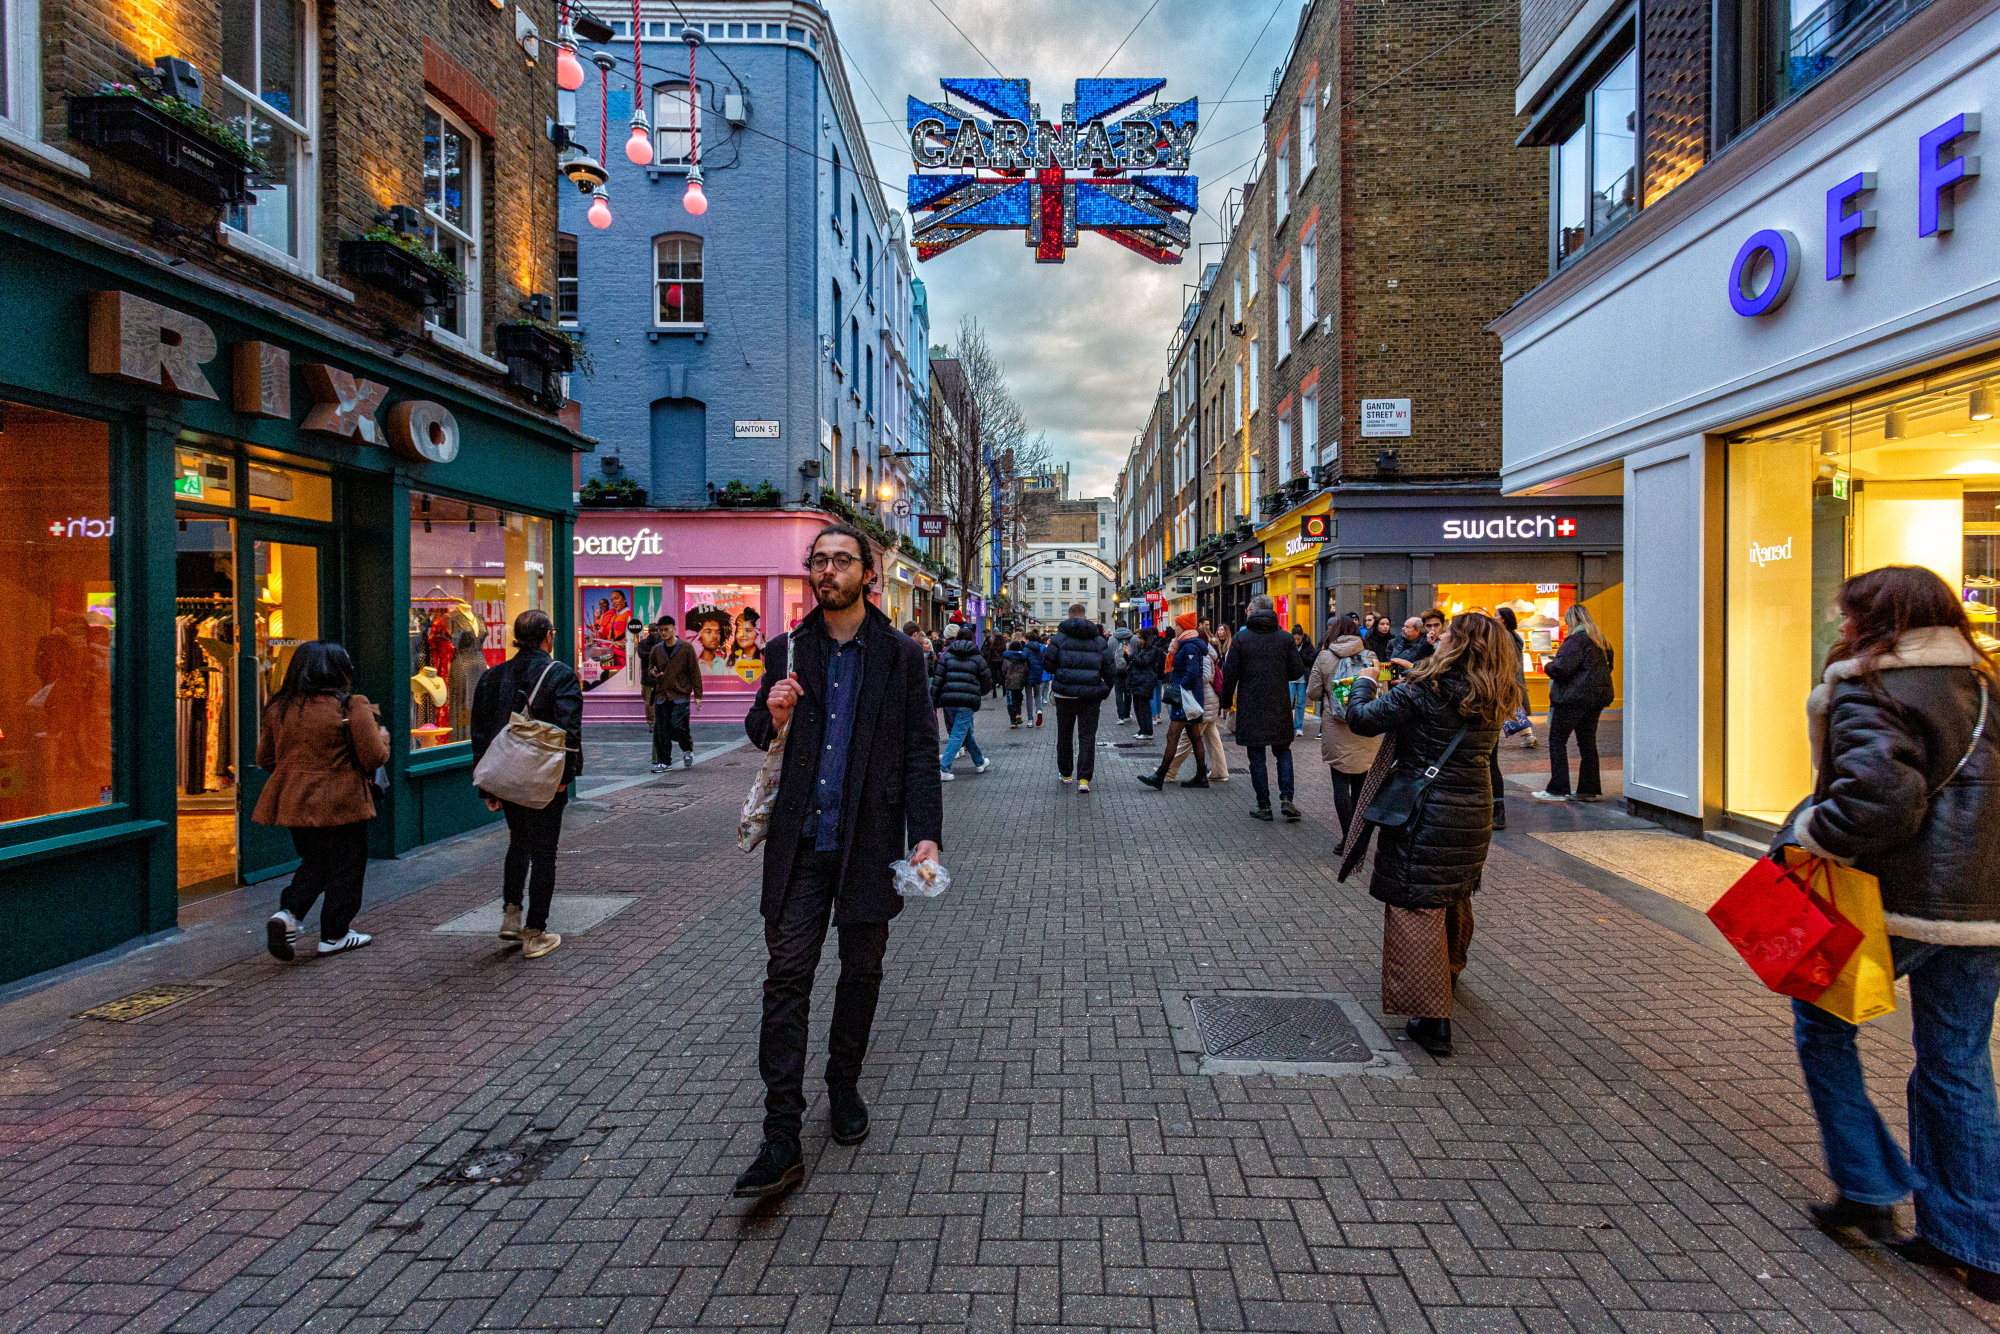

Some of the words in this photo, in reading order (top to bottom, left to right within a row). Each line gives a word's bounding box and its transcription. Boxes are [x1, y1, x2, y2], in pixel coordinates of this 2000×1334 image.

[910, 118, 1195, 170] CARNABY
[89, 291, 460, 463] RIXO
[1366, 402, 1396, 410] GANTON
[923, 521, 942, 530] MUJI
[1443, 515, 1555, 539] swatch
[1069, 553, 1094, 564] CARNABY
[1096, 563, 1113, 577] STREET
[698, 601, 745, 614] Brows
